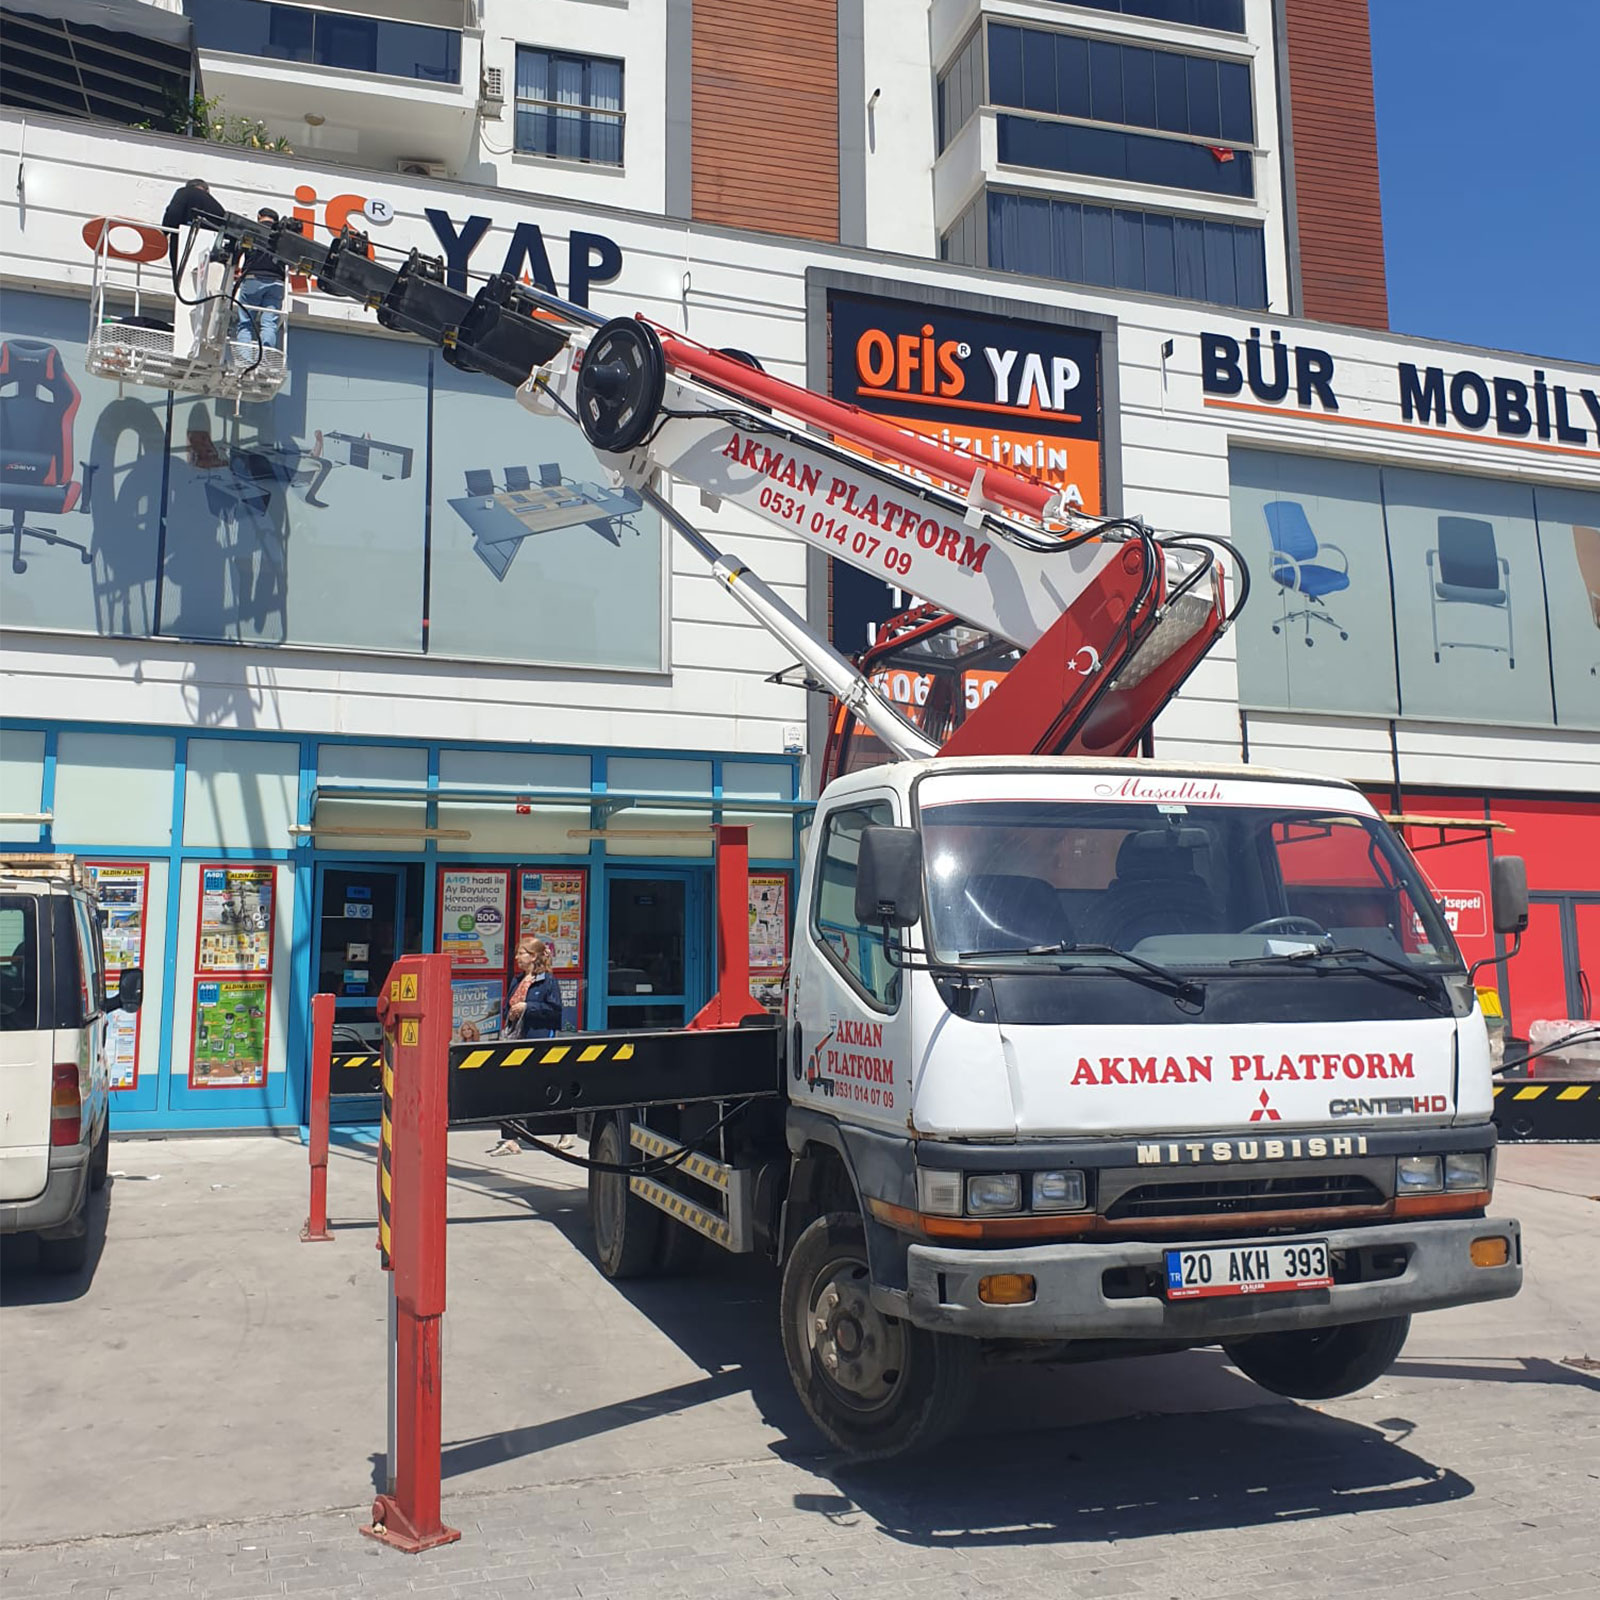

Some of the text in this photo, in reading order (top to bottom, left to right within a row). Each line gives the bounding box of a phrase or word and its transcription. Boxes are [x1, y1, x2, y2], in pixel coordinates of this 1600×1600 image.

[424, 207, 623, 310] YAP
[984, 346, 1081, 411] YAP
[1200, 328, 1339, 410] BÜR
[722, 432, 823, 496] AKMAN
[826, 477, 991, 573] PLATFORM
[759, 487, 912, 575] 0531 014 07 09
[446, 886, 500, 895] Ay Boyunca
[836, 1020, 883, 1048] AKMAN
[827, 1050, 894, 1085] PLATFORM
[1070, 1053, 1415, 1085] AKMAN PLATFORM
[835, 1081, 894, 1108] 0531 014 07 09
[1137, 1136, 1369, 1164] MITSUBISHI
[1170, 1247, 1326, 1285] TR 20 AKH 393
